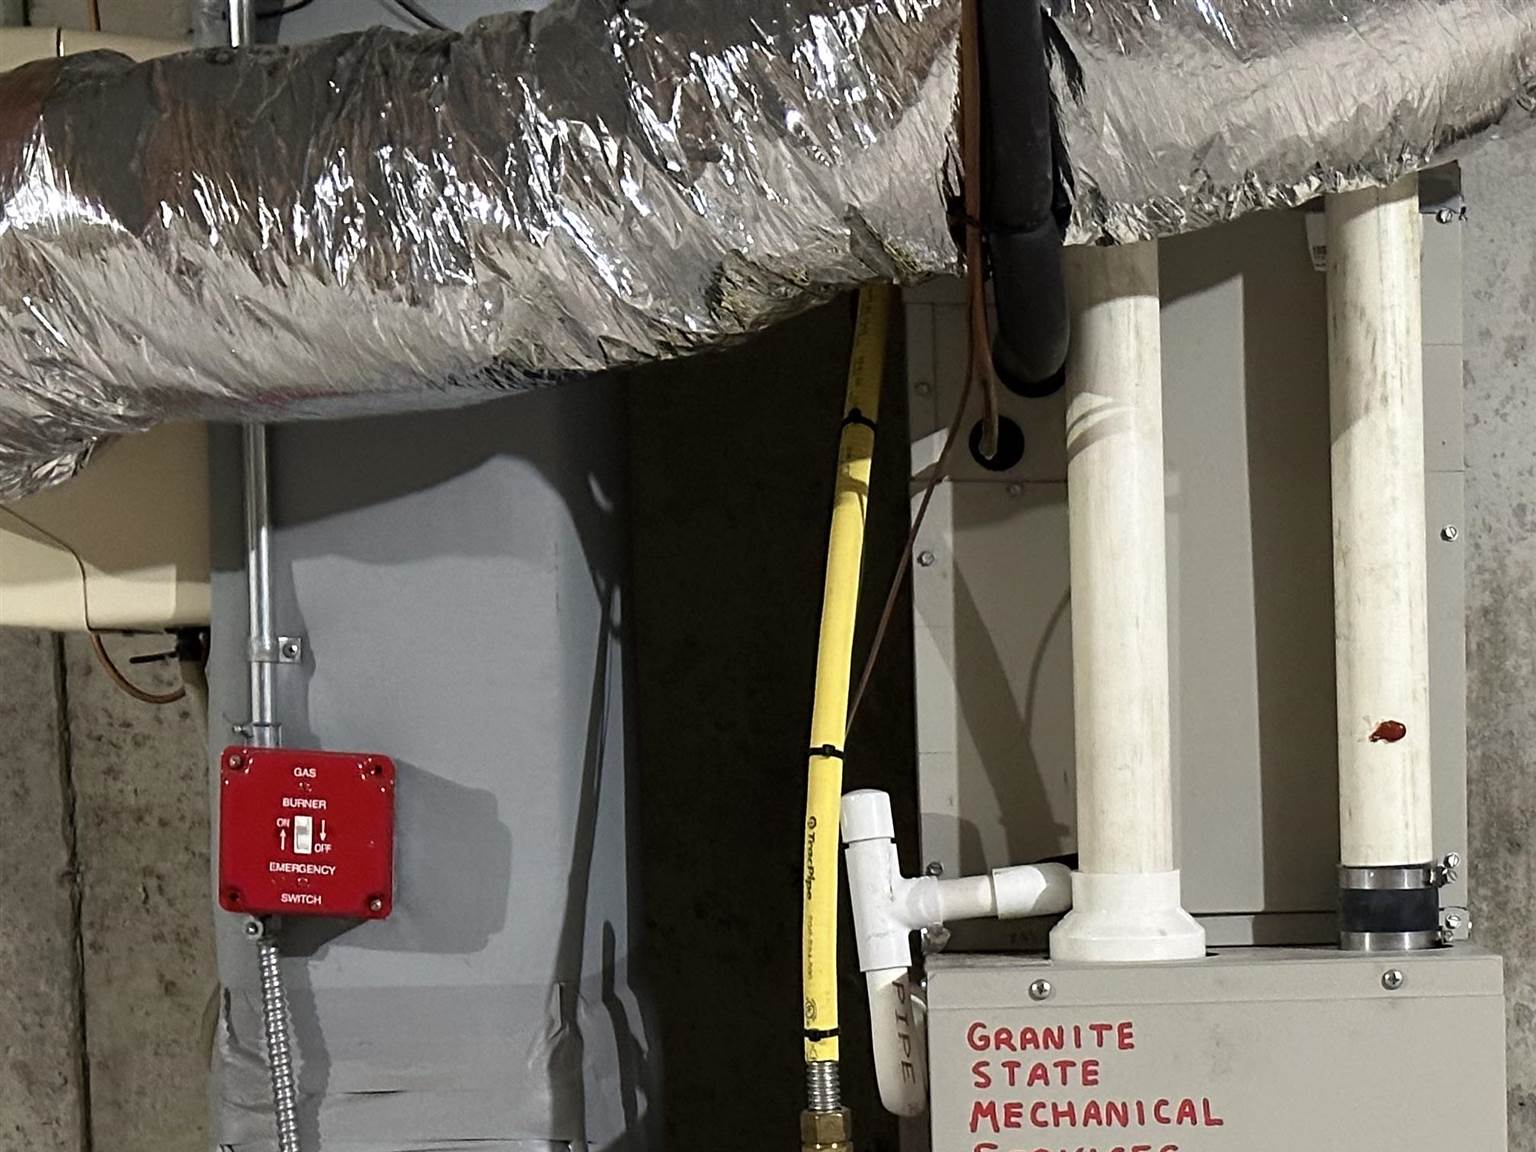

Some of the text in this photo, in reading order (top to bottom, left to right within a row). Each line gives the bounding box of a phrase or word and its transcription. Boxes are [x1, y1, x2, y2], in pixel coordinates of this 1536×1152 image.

[294, 767, 316, 778] GAS
[283, 798, 326, 809] BURNER
[277, 818, 290, 827] ON
[314, 843, 332, 853] OFF
[270, 862, 336, 875] EMERGENCY
[281, 894, 321, 904] SWITCH
[892, 981, 915, 1084] PIPE
[967, 1021, 1135, 1052] GRANITE
[971, 1059, 1101, 1089] STATE
[969, 1097, 1224, 1134] MECHANICAL
